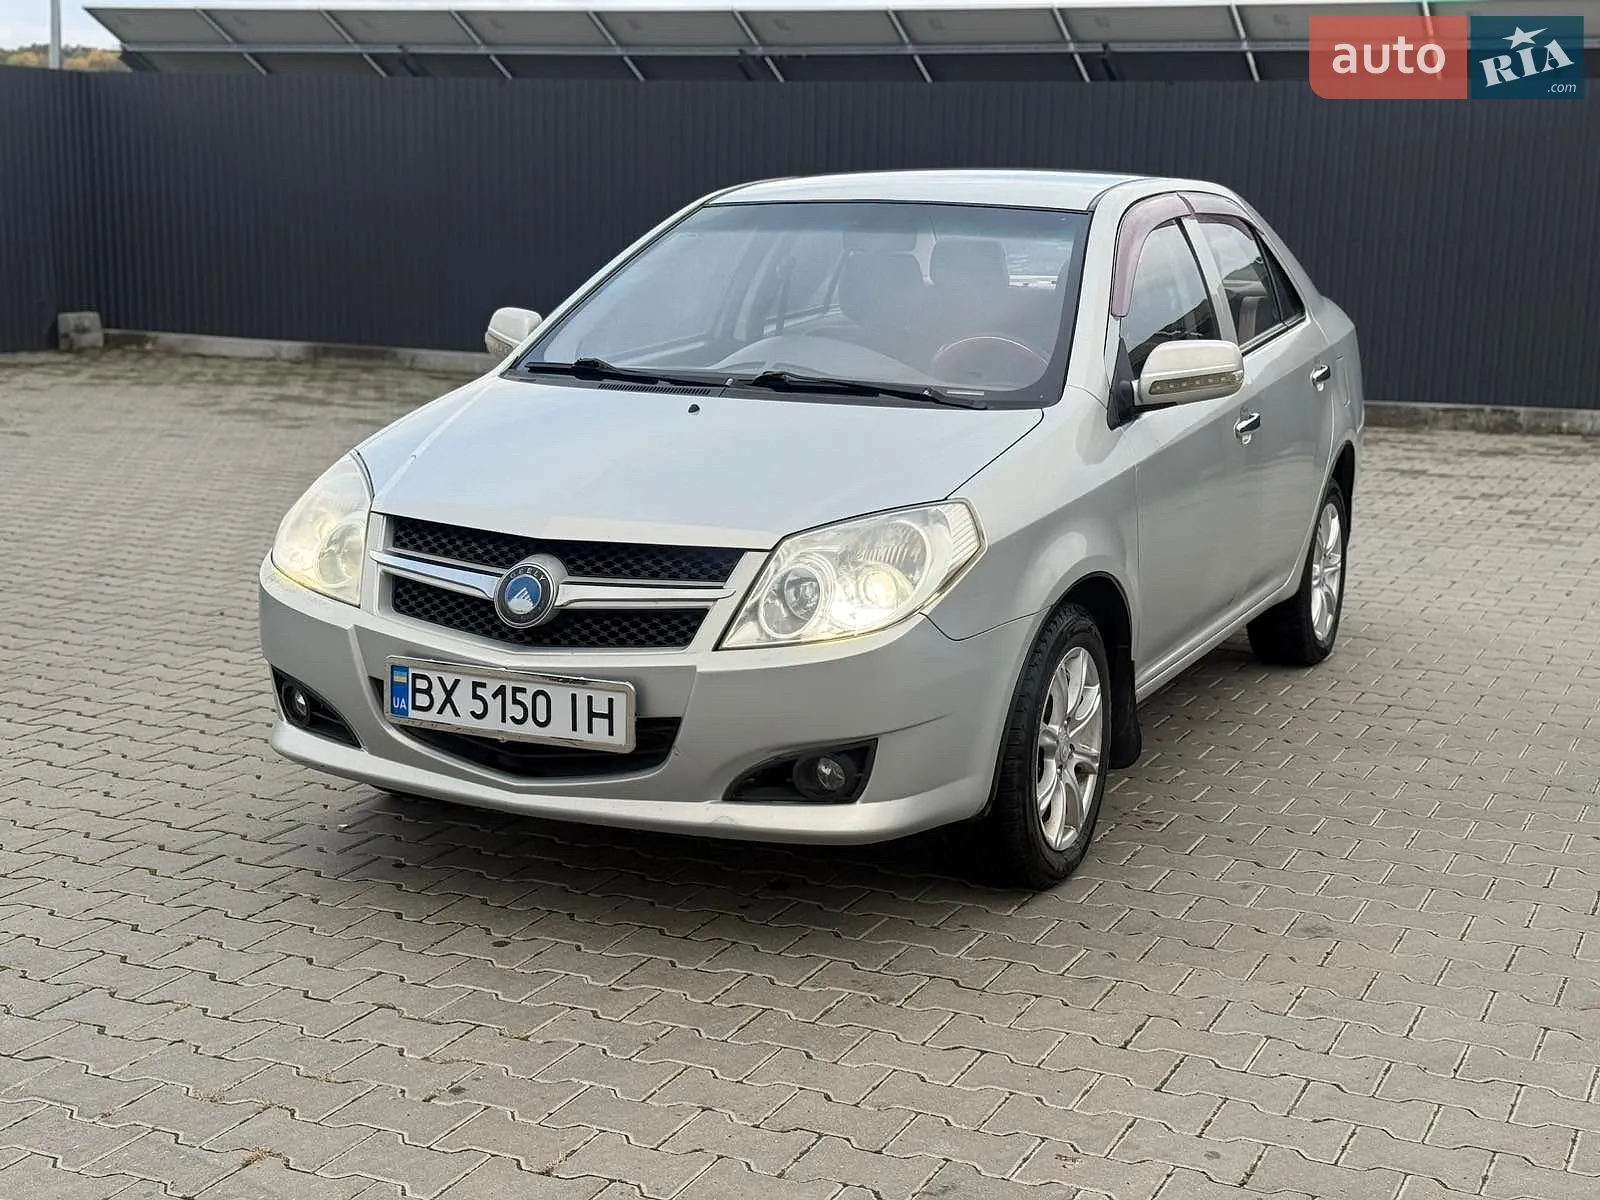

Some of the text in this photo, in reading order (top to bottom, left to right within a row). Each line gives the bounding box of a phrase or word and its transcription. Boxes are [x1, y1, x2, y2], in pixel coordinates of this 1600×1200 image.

[393, 697, 407, 710] UA
[411, 672, 614, 737] BX 5150 IH
